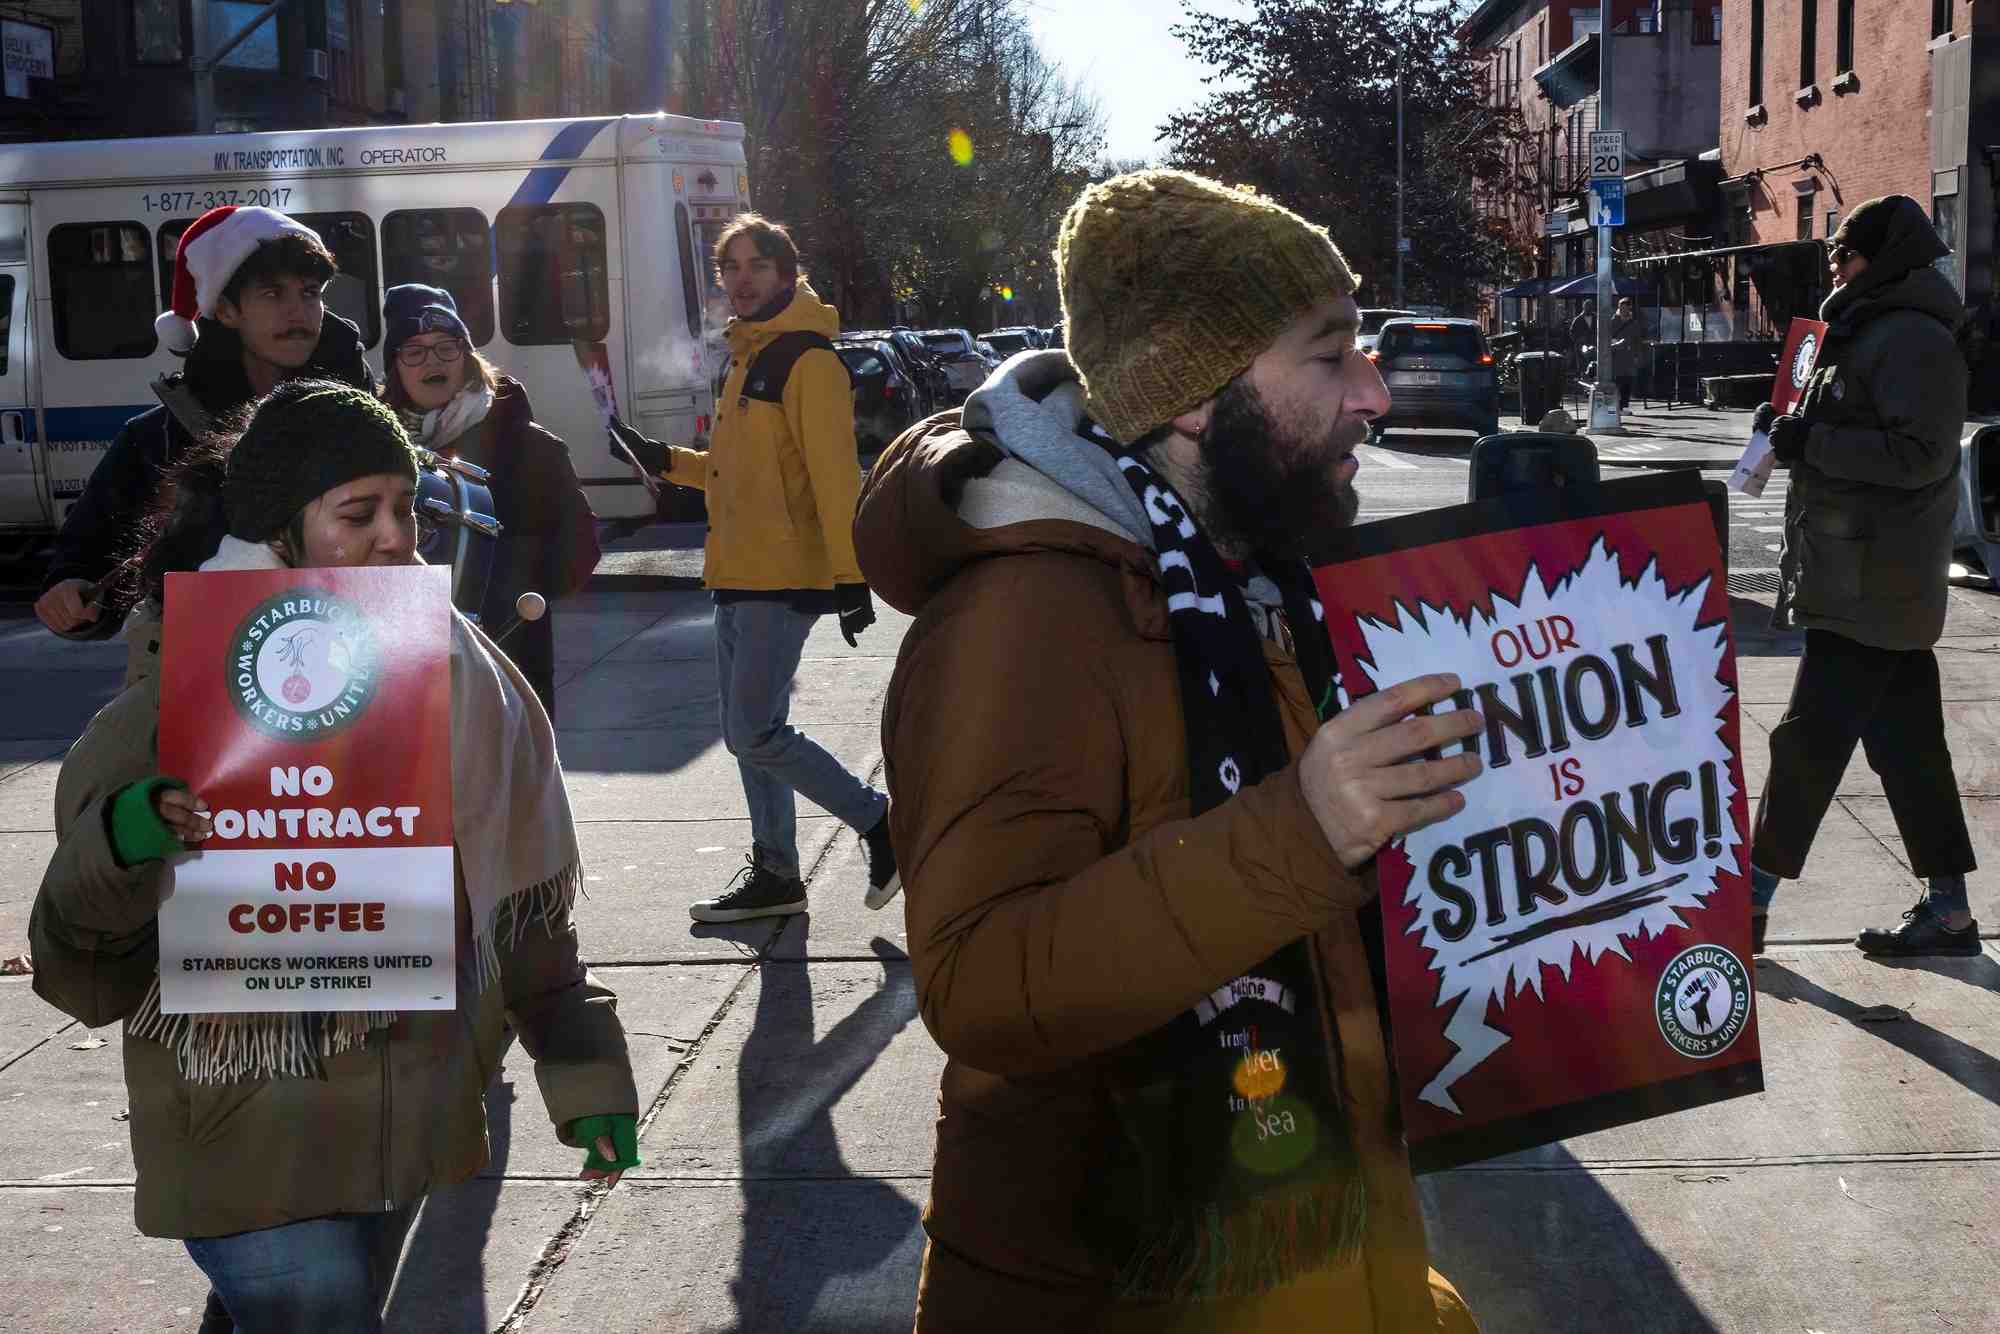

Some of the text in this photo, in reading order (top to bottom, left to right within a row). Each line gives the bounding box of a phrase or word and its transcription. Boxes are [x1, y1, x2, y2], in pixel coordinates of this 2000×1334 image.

[1593, 135, 1620, 144] SPEED
[1594, 145, 1618, 153] LIMIT
[360, 147, 447, 165] OPERATOR
[1594, 156, 1619, 172] 20
[143, 187, 292, 211] 1-877-337-2017
[1490, 614, 1581, 668] OUR
[238, 655, 303, 732] WORKERS
[270, 765, 334, 797] NO
[1548, 757, 1586, 801] IS
[1427, 761, 1723, 943] STRONG!
[273, 861, 337, 892] NO
[228, 902, 386, 934] COFFEE
[182, 954, 433, 972] STARBUCKS WORKERS UNITED
[1666, 950, 1737, 988] STARBUCKS
[245, 975, 372, 990] ON ULP STRIKE!
[1662, 1007, 1707, 1051] WORKERS
[1719, 990, 1745, 1041] UNITED
[1256, 1110, 1296, 1143] Sea
